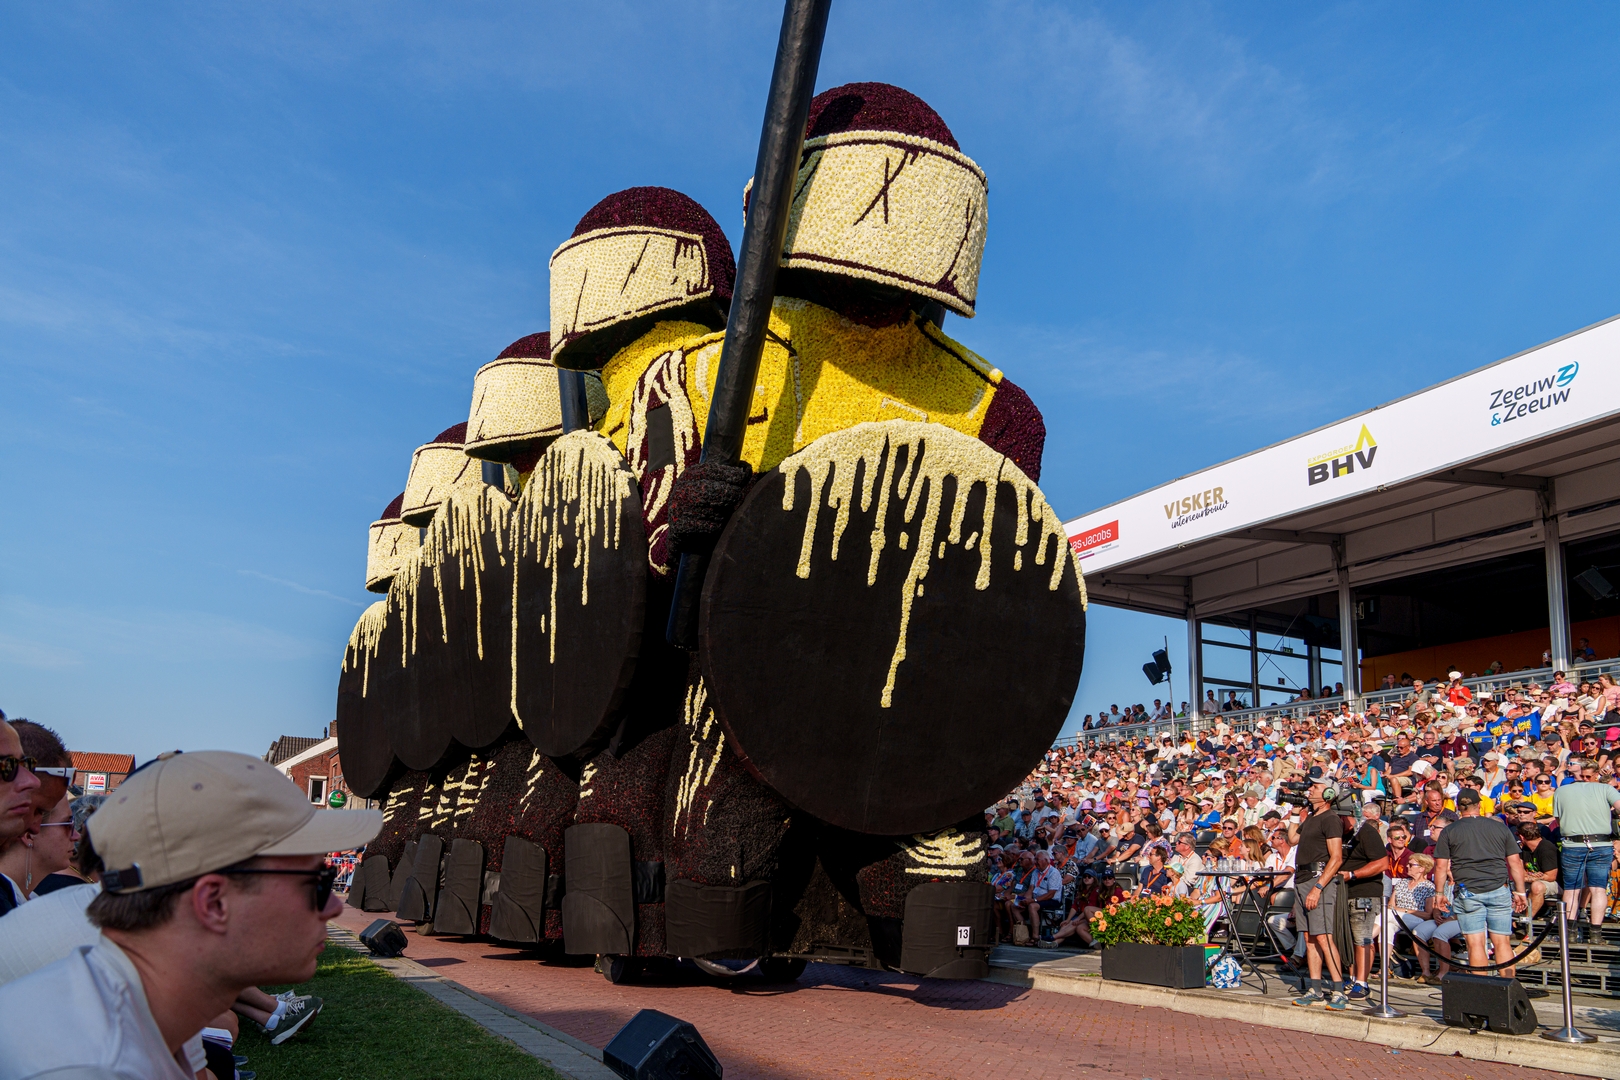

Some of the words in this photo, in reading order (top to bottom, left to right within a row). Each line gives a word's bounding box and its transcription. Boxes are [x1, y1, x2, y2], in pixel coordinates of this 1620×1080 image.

[1489, 374, 1556, 410] Zeeuw
[1307, 444, 1354, 464] EXPOGROEP
[1307, 445, 1378, 486] BHV
[1163, 486, 1225, 520] VISKER
[958, 928, 969, 939] 13
